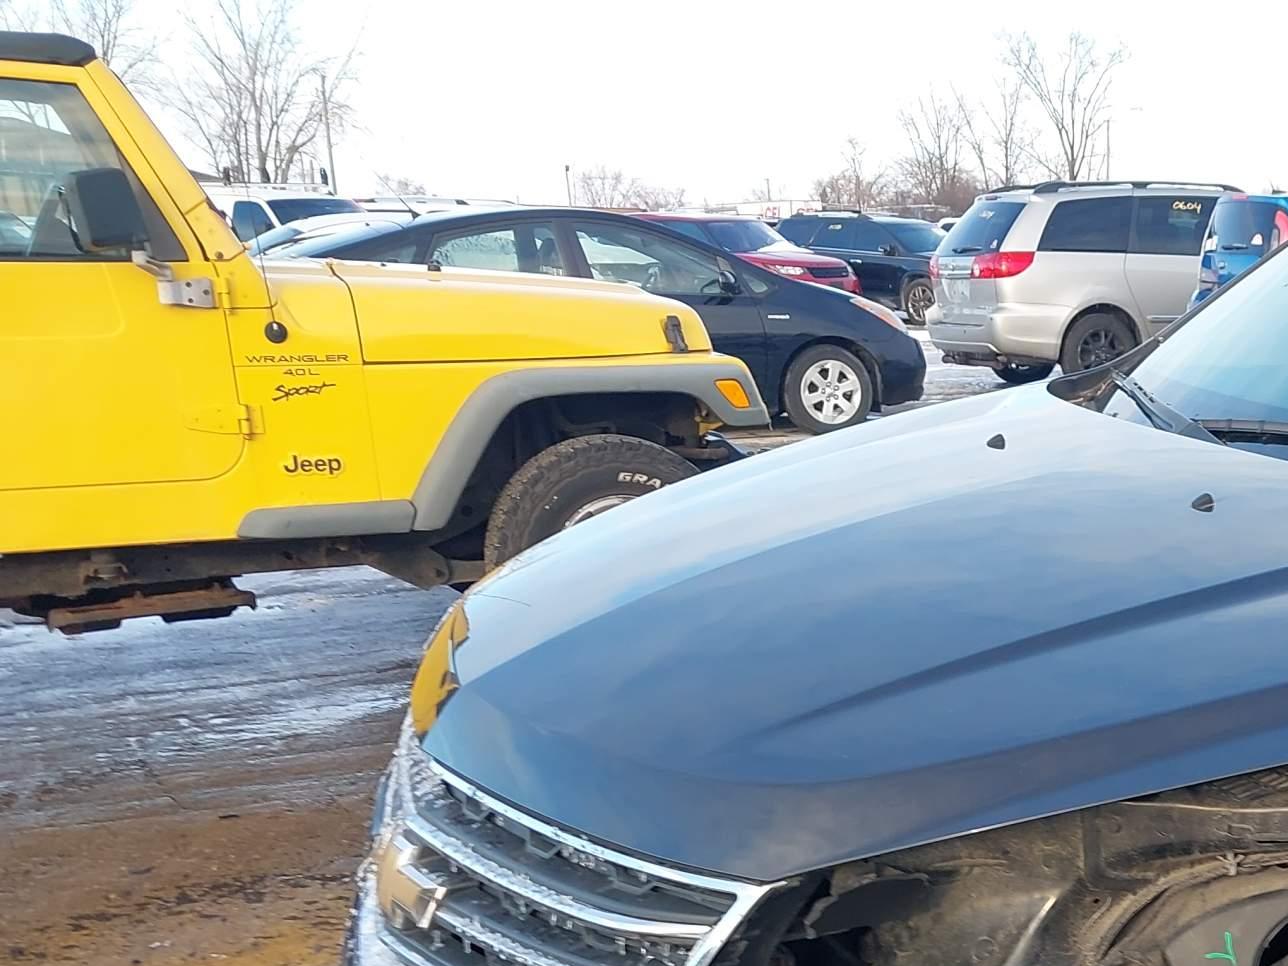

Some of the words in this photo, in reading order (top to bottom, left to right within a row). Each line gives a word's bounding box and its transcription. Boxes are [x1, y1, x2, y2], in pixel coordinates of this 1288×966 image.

[245, 354, 349, 363] WRANGLER
[284, 455, 341, 475] Jeep
[617, 472, 668, 489] GRA
